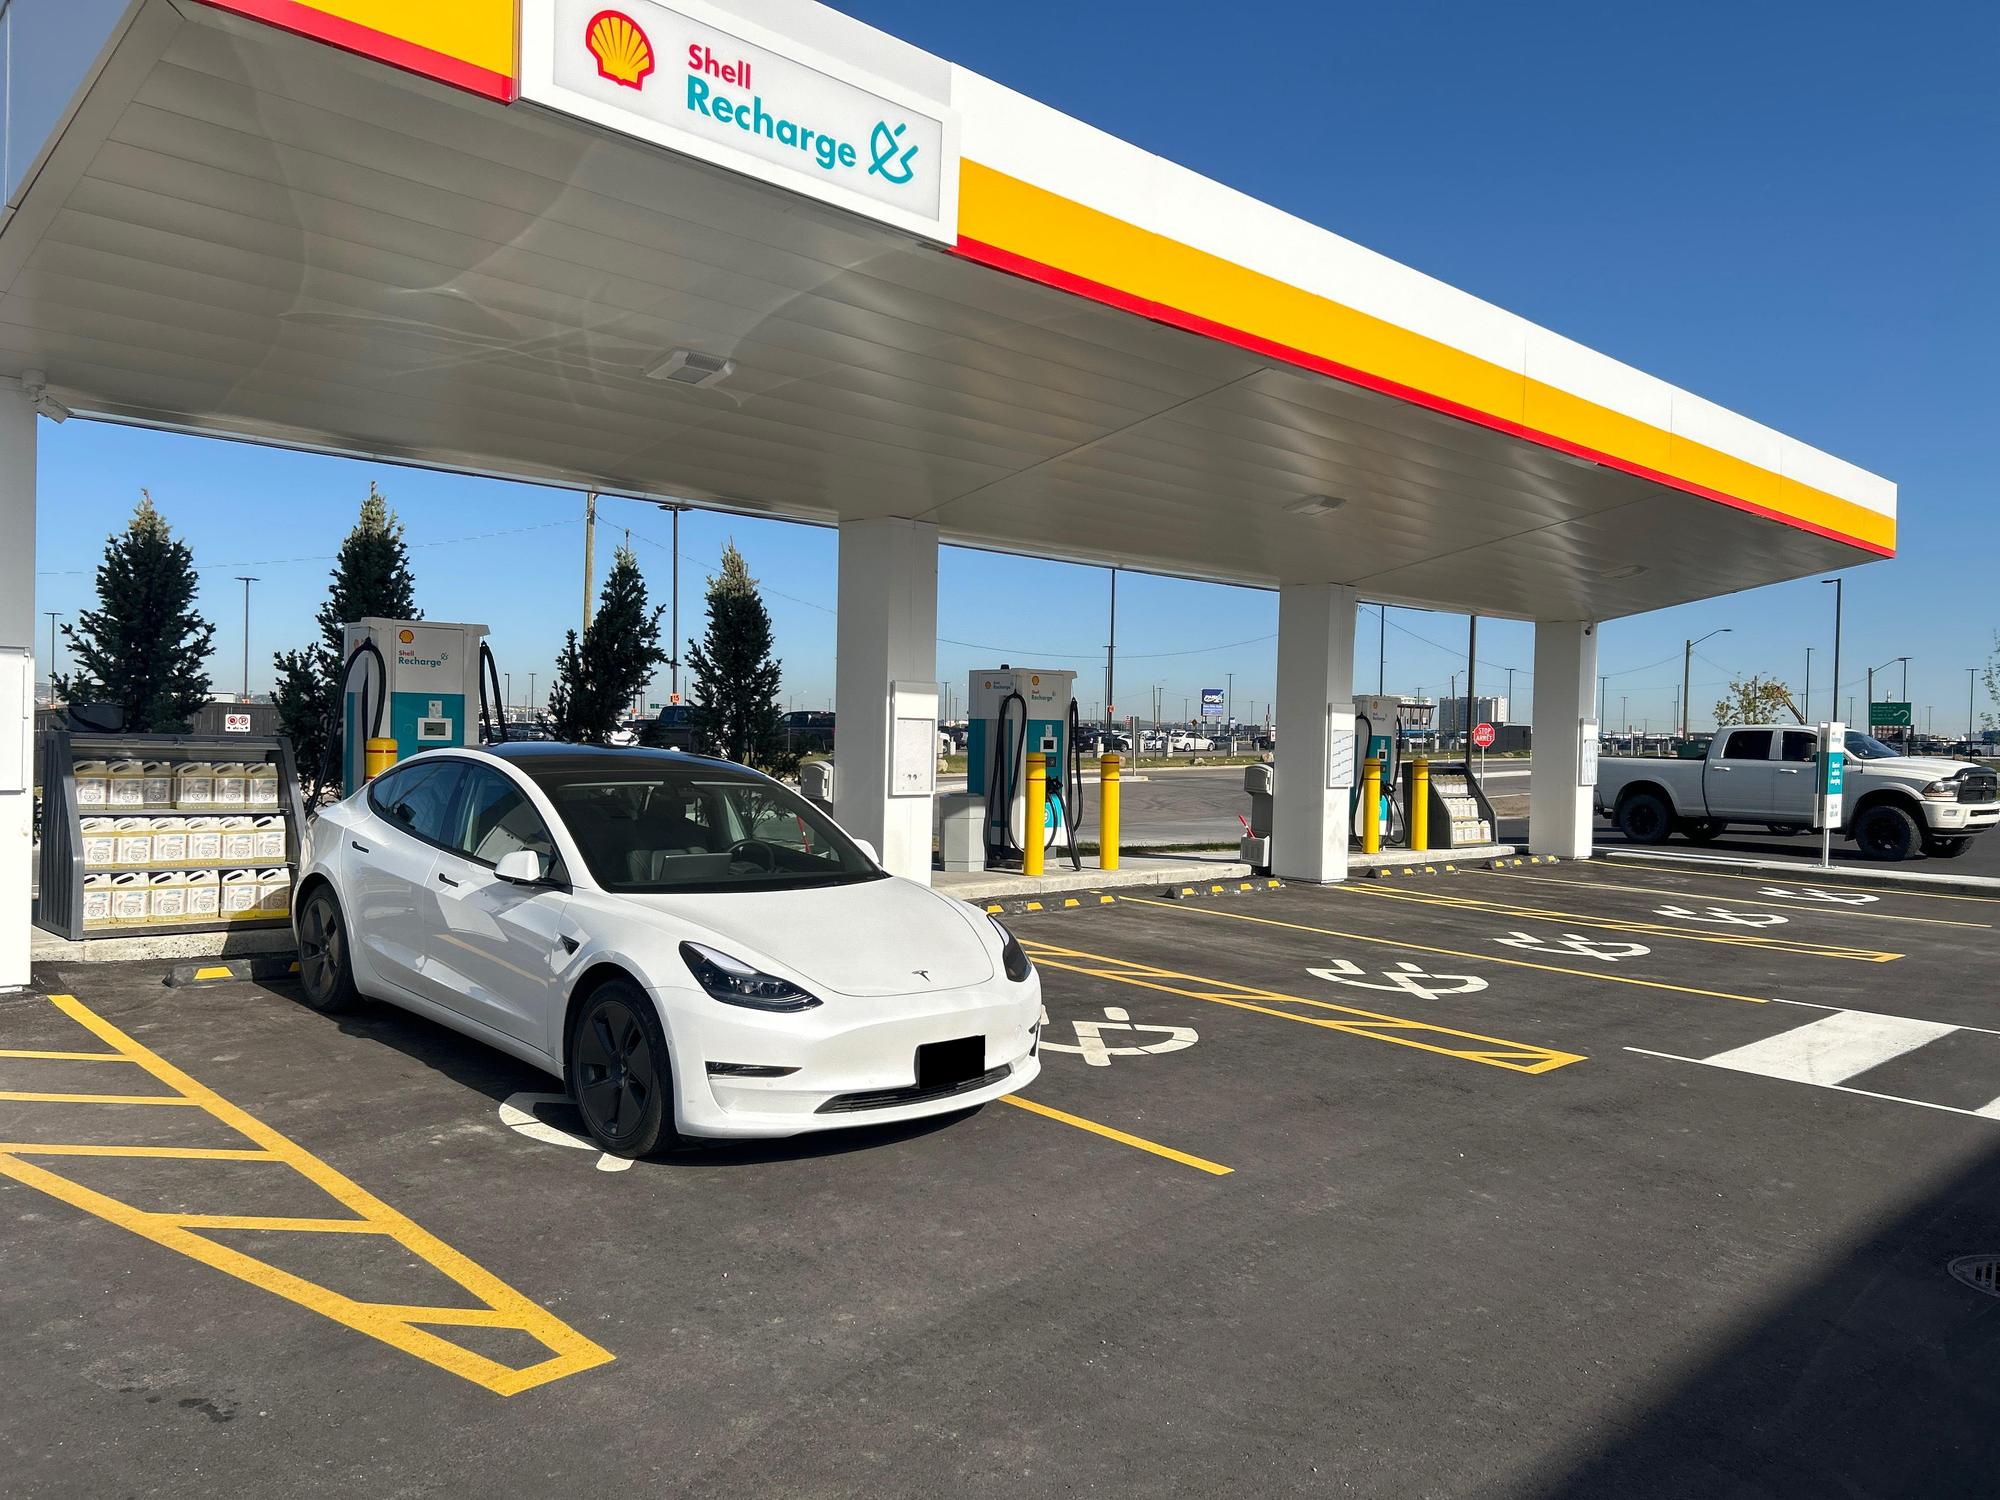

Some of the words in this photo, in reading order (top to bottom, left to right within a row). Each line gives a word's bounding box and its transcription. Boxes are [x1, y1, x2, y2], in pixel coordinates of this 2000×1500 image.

[688, 44, 751, 90] Shell
[687, 74, 857, 170] Recharge
[398, 656, 441, 668] Recharge
